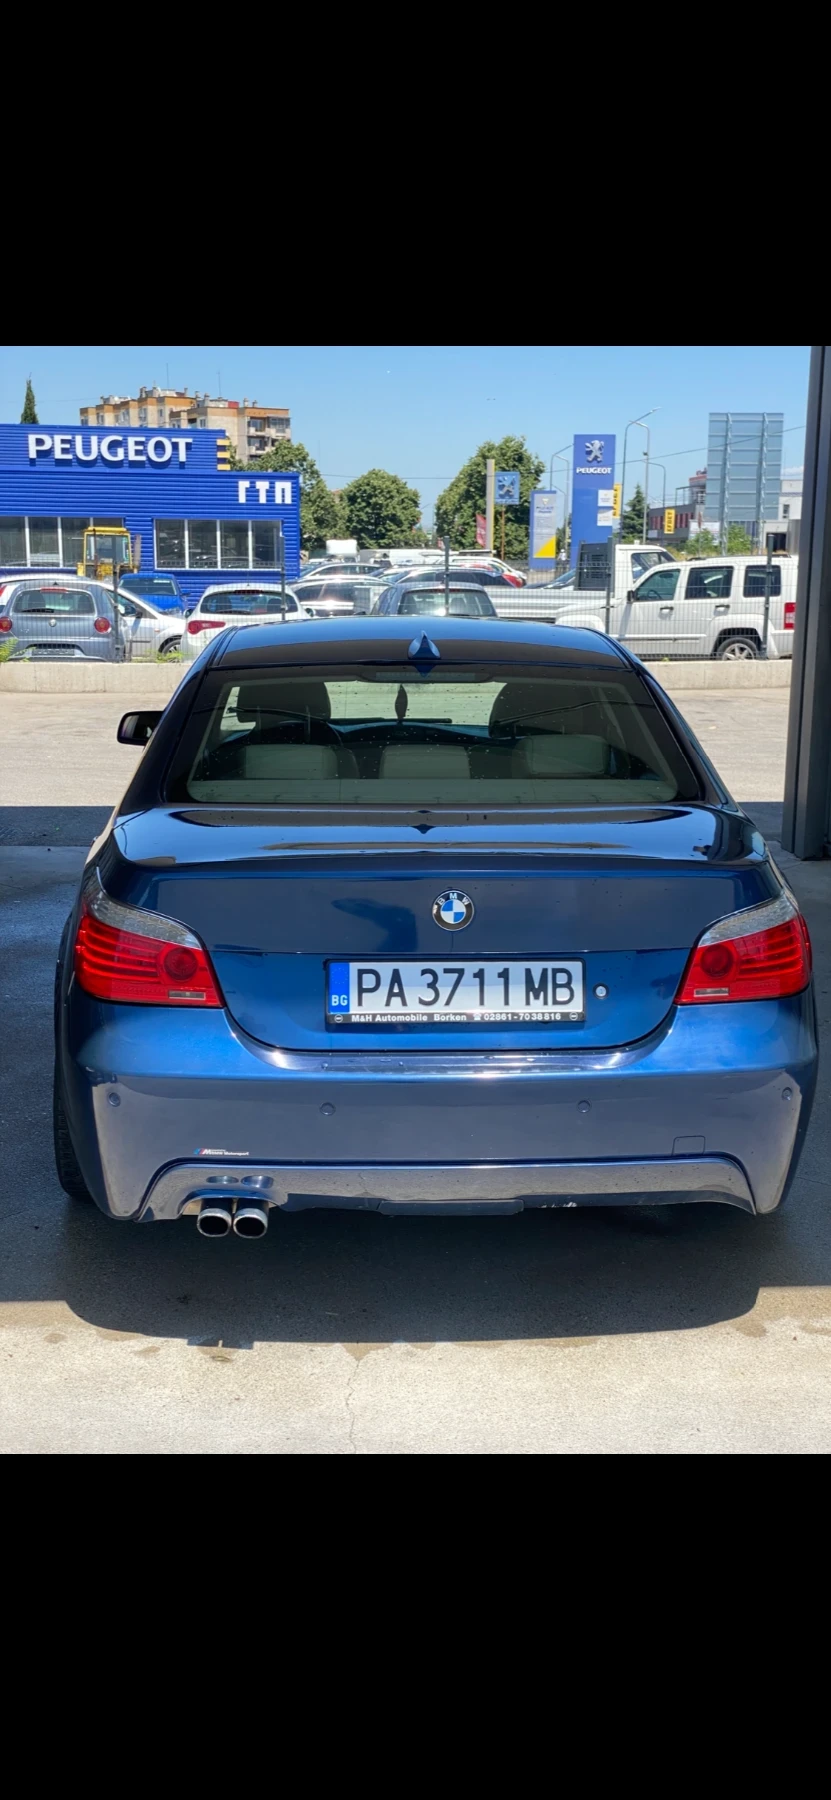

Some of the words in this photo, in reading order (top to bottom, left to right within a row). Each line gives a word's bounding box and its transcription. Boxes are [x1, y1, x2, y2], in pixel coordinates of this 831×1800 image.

[28, 434, 193, 463] PEUGEOT
[238, 481, 292, 504] ГТП
[437, 892, 470, 905] BMW
[418, 968, 510, 1006] 3711
[331, 995, 348, 1006] BG
[351, 1014, 373, 1023] M&H
[375, 1013, 428, 1022] Automobile
[433, 1012, 467, 1021] Borken
